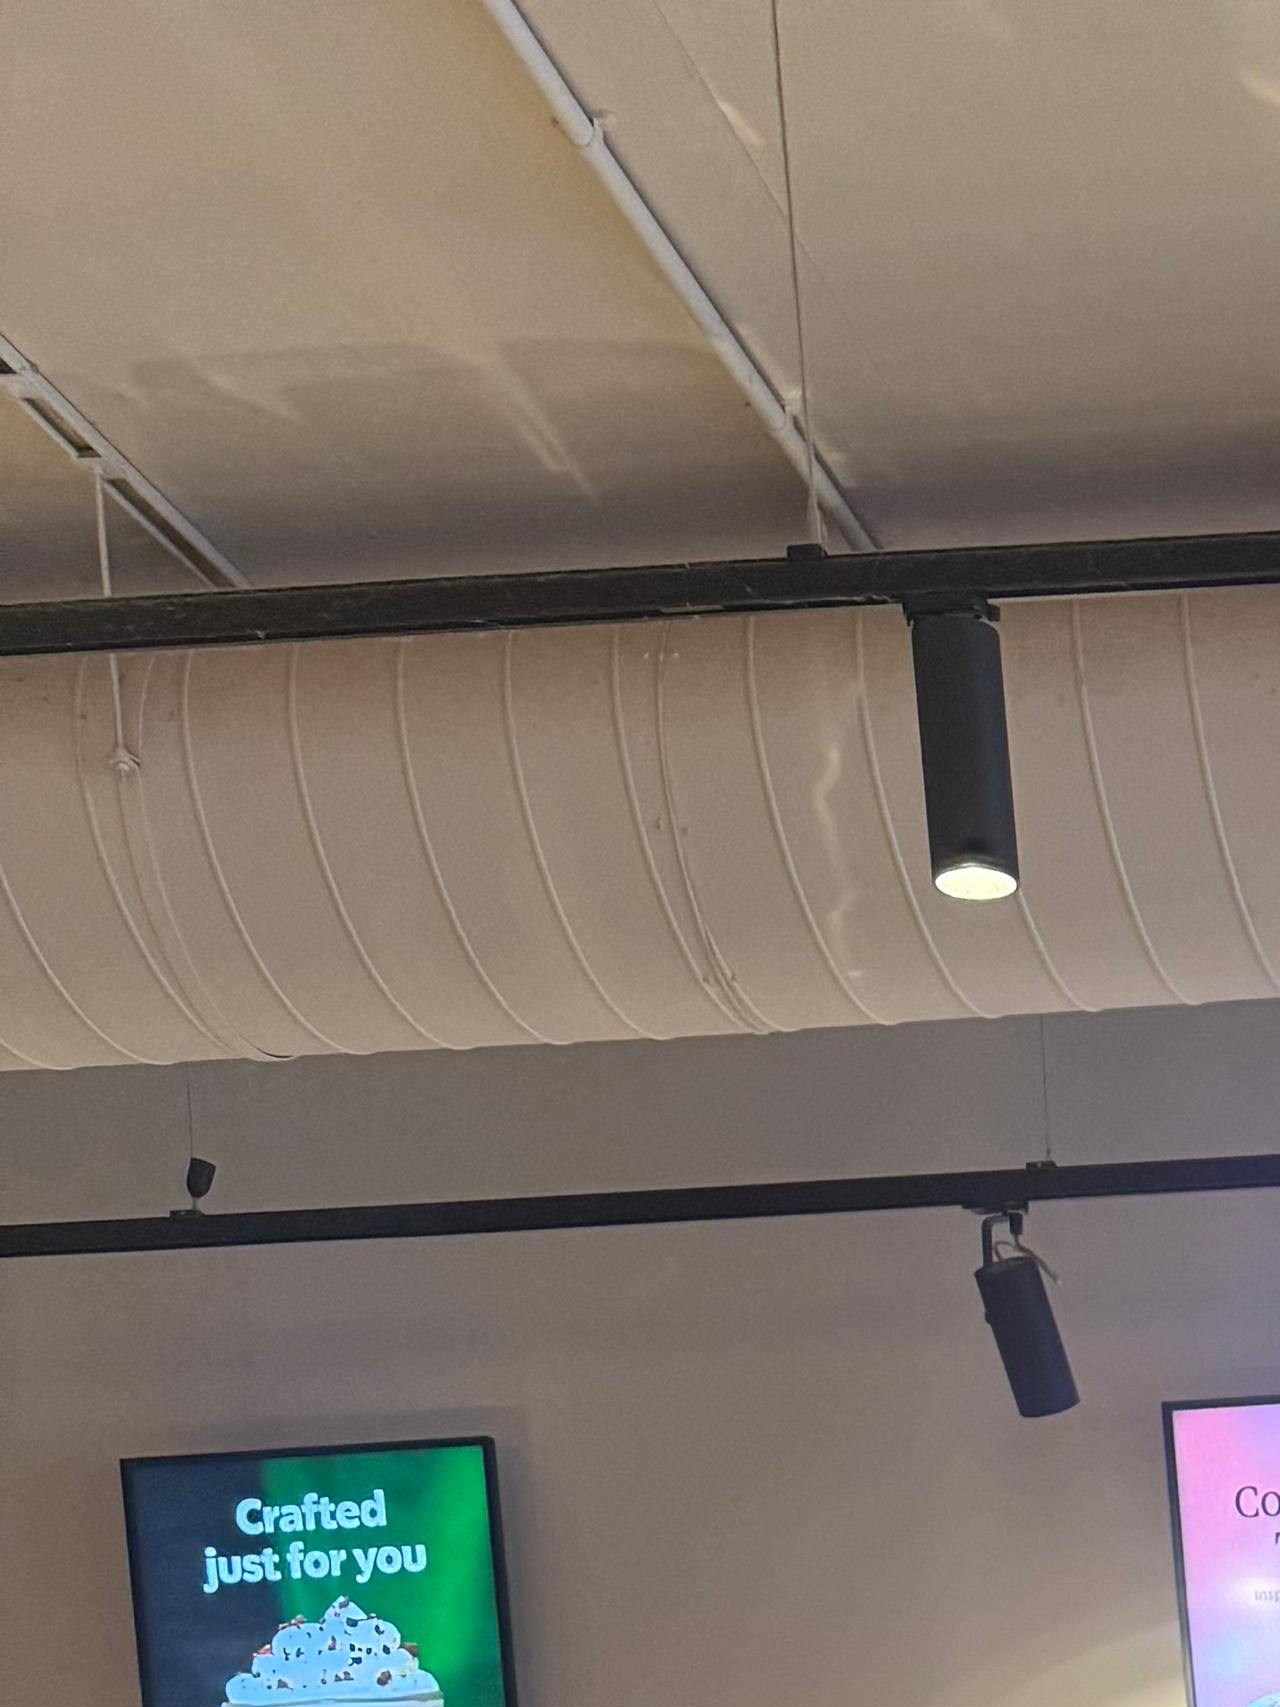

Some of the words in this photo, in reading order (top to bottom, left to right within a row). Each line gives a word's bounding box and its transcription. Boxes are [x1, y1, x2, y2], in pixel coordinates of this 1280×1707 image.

[234, 1489, 387, 1535] Crafted
[202, 1546, 281, 1593] just
[286, 1541, 347, 1580] for
[350, 1543, 427, 1583] you
